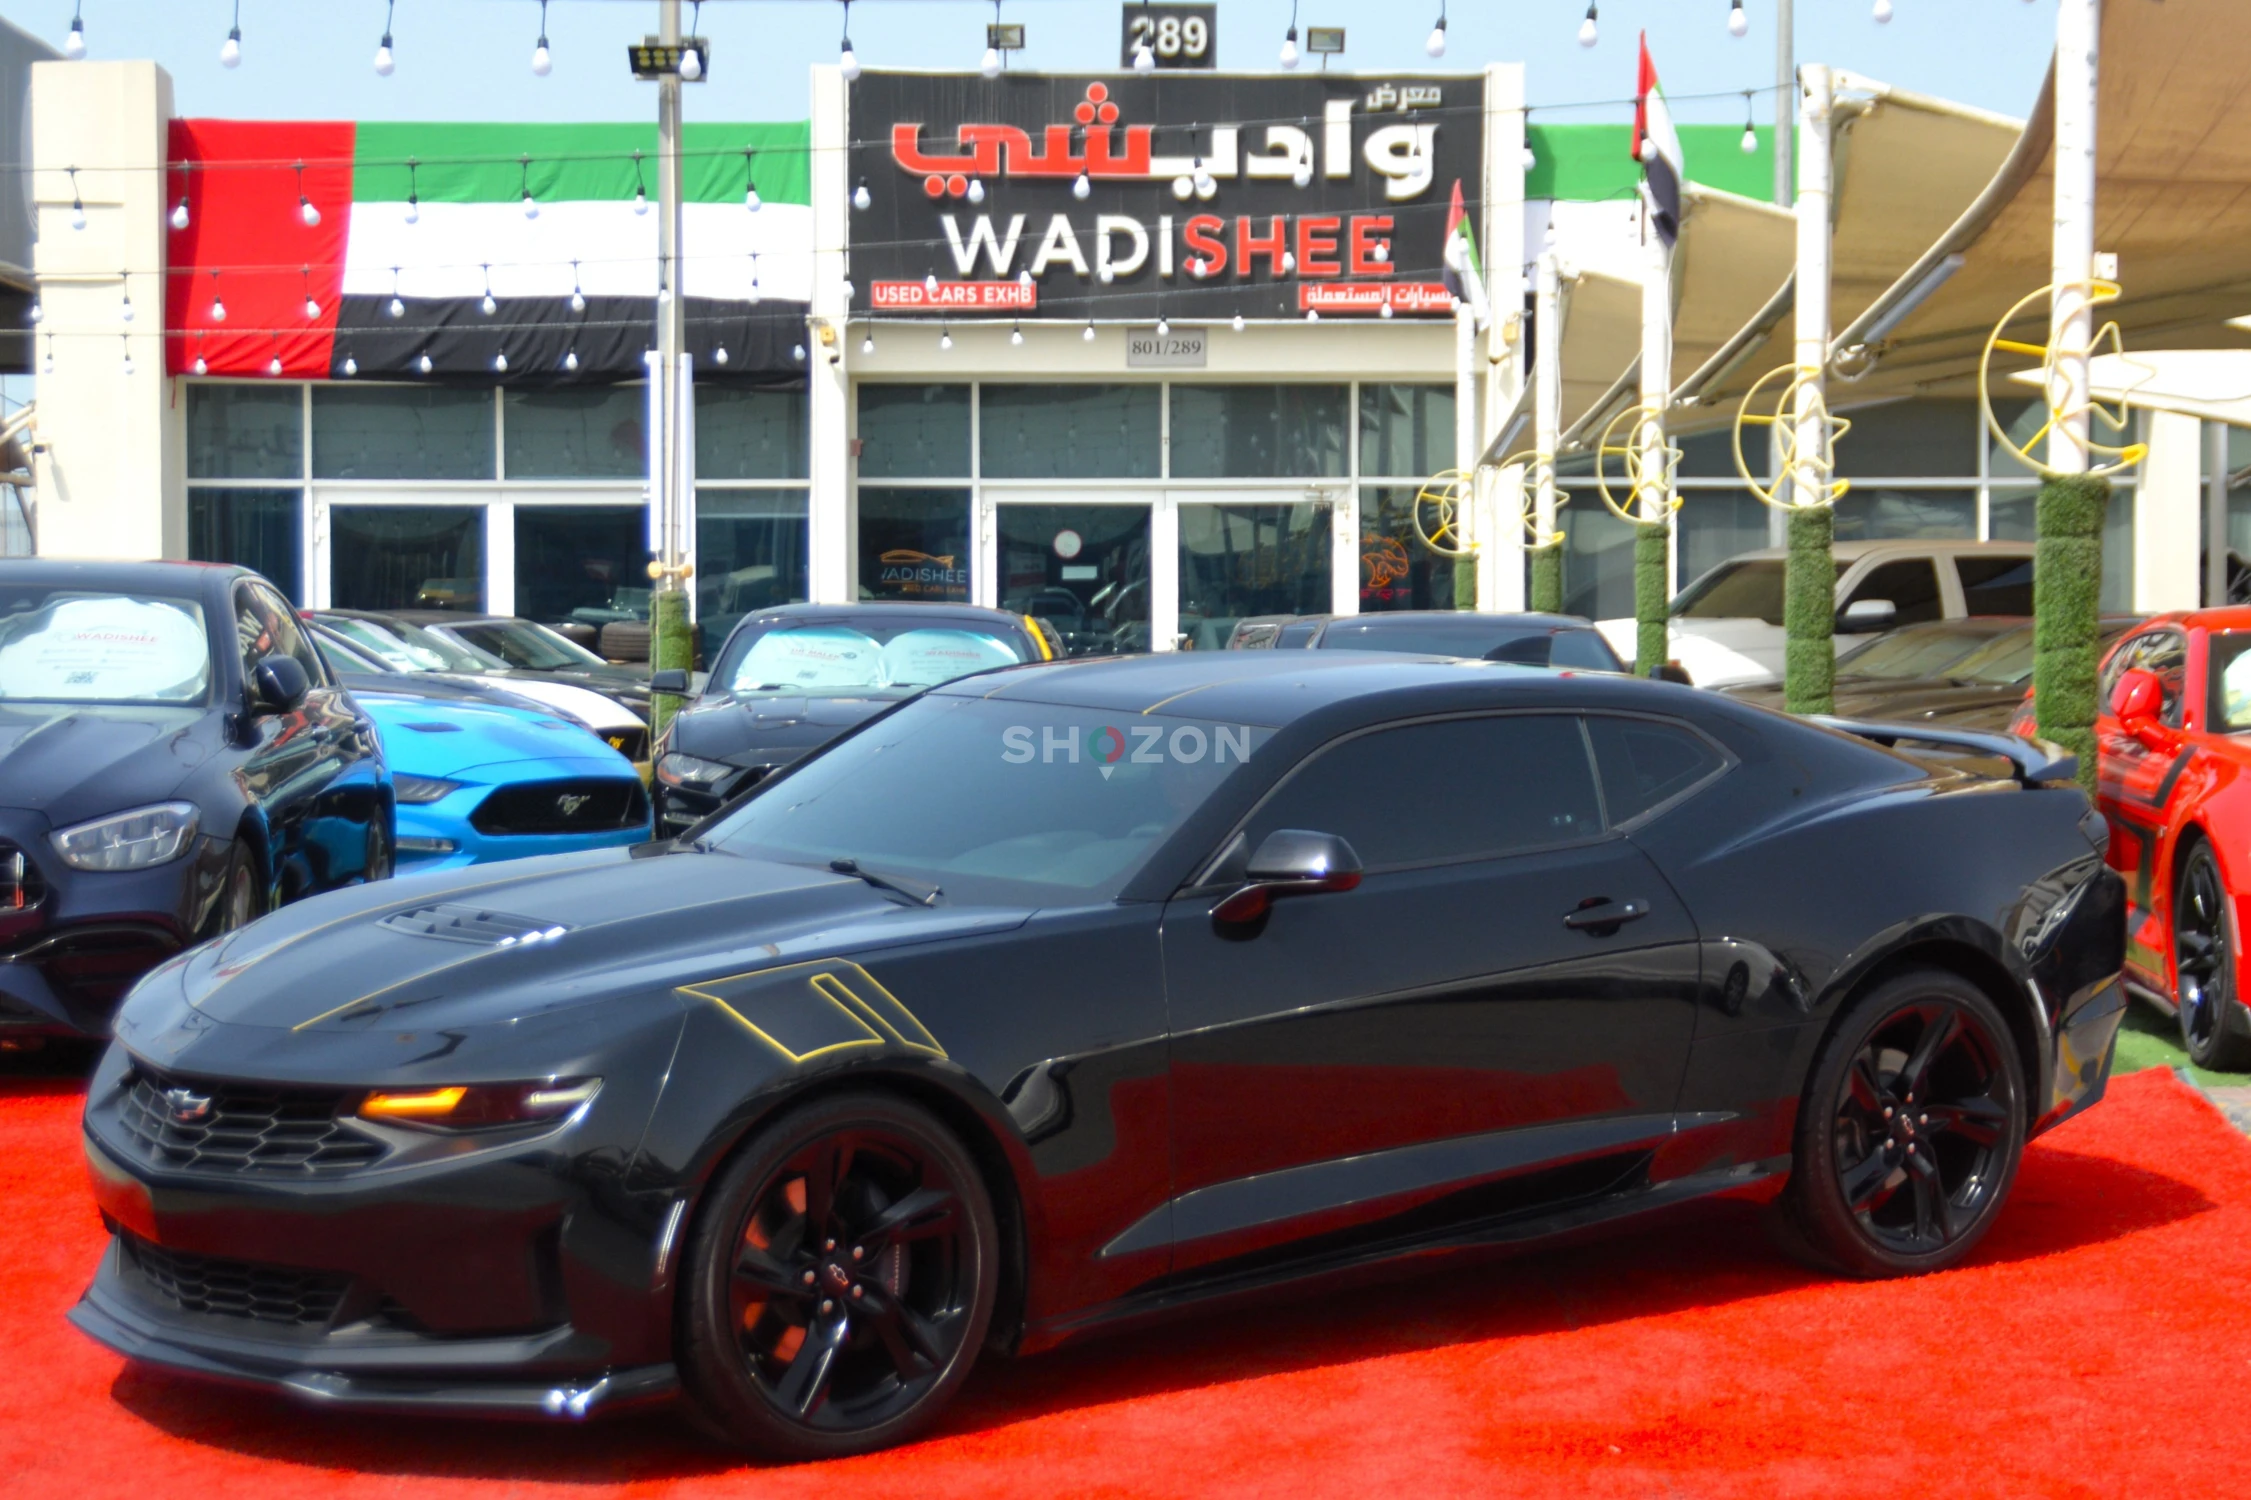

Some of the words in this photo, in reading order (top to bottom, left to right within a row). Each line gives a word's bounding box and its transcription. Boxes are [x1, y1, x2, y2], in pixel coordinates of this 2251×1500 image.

[1129, 15, 1208, 57] 289
[1367, 82, 1441, 113] معرض
[941, 214, 1395, 277] WADISHEE
[875, 286, 922, 303] USED
[927, 286, 977, 303] CARS
[984, 286, 1033, 303] EXHB
[1132, 340, 1202, 355] 801/289
